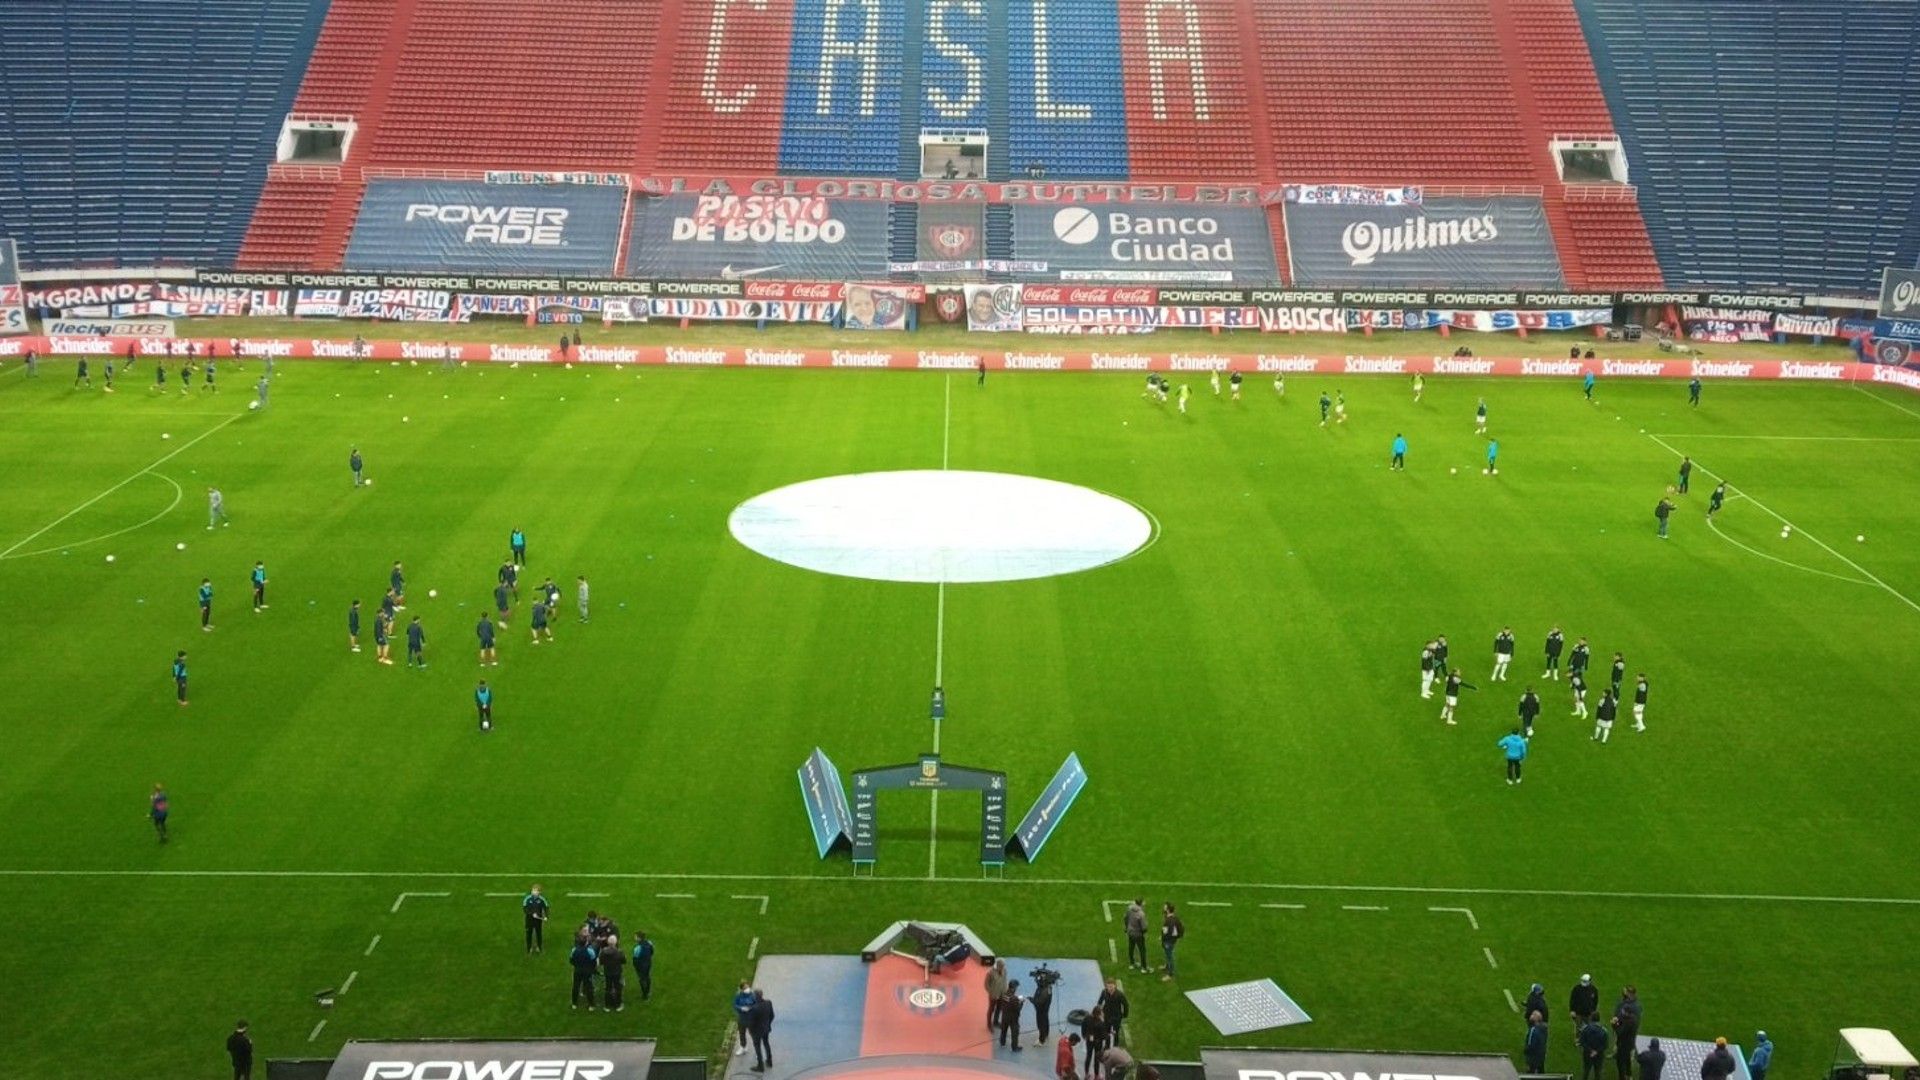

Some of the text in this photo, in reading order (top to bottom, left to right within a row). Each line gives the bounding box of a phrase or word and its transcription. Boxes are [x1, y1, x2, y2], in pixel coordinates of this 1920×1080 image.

[752, 179, 985, 200] GLORIOSA
[1001, 183, 1257, 204] BUTTELER
[405, 204, 569, 226] POWER
[672, 217, 846, 244] DE BOEDO
[1109, 213, 1218, 236] Banco
[465, 225, 563, 245] ADE
[1342, 214, 1498, 266] Quilmes
[1110, 237, 1234, 262] Ciudad
[199, 273, 289, 286] POWERADE
[292, 275, 378, 287] POWERADE
[383, 277, 471, 288] POWERADE
[475, 279, 562, 290] POWERADE
[567, 281, 652, 292] POWERADE
[297, 289, 342, 304] LEO
[658, 283, 741, 295] POWERADE
[1159, 291, 1244, 302] POWERADE
[1251, 292, 1336, 303] POWERADE
[349, 289, 450, 310] ROSARIO
[1341, 292, 1428, 304] POWERADE
[1433, 293, 1518, 304] POWERADE
[1525, 294, 1612, 306] POWERADE
[1622, 293, 1699, 304] POWERADE
[1708, 295, 1802, 308] POWERADE
[651, 299, 741, 318] CIUDAD
[766, 302, 842, 322] EVITA
[50, 337, 113, 354] Schneider
[489, 344, 552, 361] Schneider
[578, 345, 639, 362] Schneider
[665, 346, 727, 364] Schneider
[745, 347, 806, 365] Schneider
[831, 349, 892, 366] Schneider
[917, 351, 979, 368] Schneider
[1004, 352, 1065, 369] Schneider
[1091, 352, 1152, 370] Schneider
[1170, 353, 1231, 370] Schneider
[1257, 354, 1319, 371] Schneider
[1344, 355, 1407, 372] Schneider
[1433, 356, 1495, 374] Schneider
[1521, 358, 1583, 375] Schneider
[1602, 359, 1665, 376] Schneider
[1691, 360, 1754, 377] Schneider
[1780, 361, 1844, 378] Schneider
[363, 1060, 615, 1080] POWER
